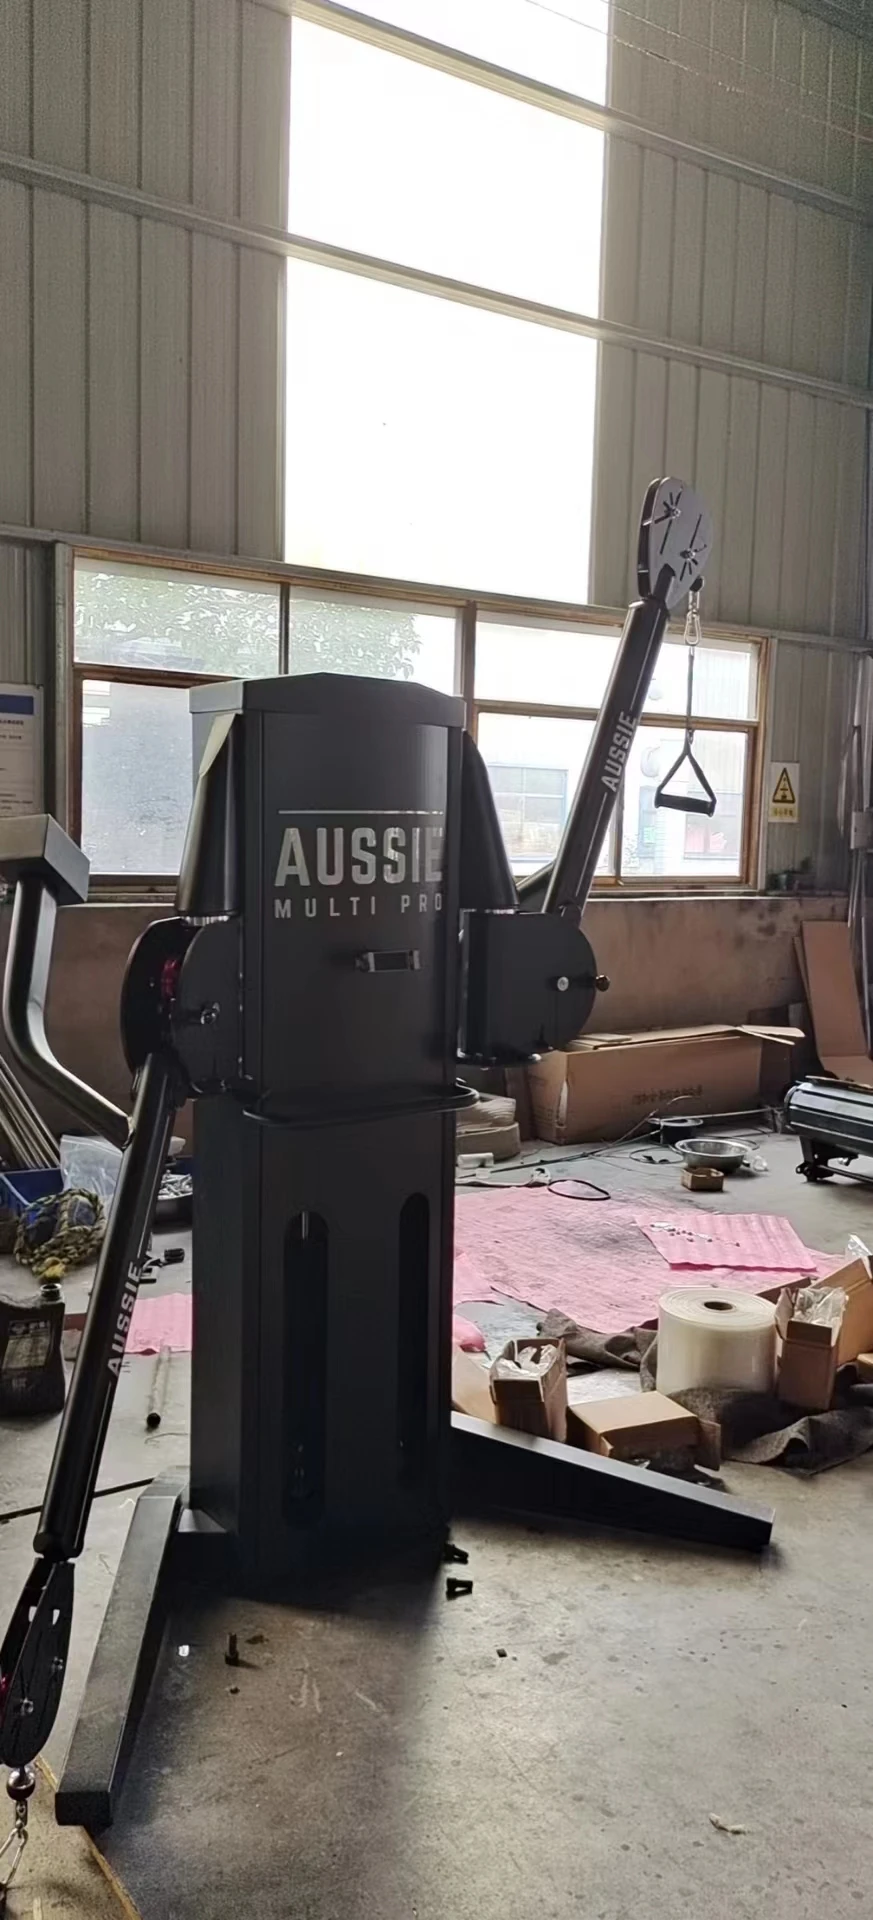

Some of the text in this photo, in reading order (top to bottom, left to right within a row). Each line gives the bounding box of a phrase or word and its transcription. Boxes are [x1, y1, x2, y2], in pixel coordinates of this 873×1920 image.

[601, 711, 637, 792] AUSSIE
[274, 827, 443, 886] AUSSIE
[275, 893, 442, 918] MULTI PRO
[107, 1262, 140, 1377] AUSSIE
